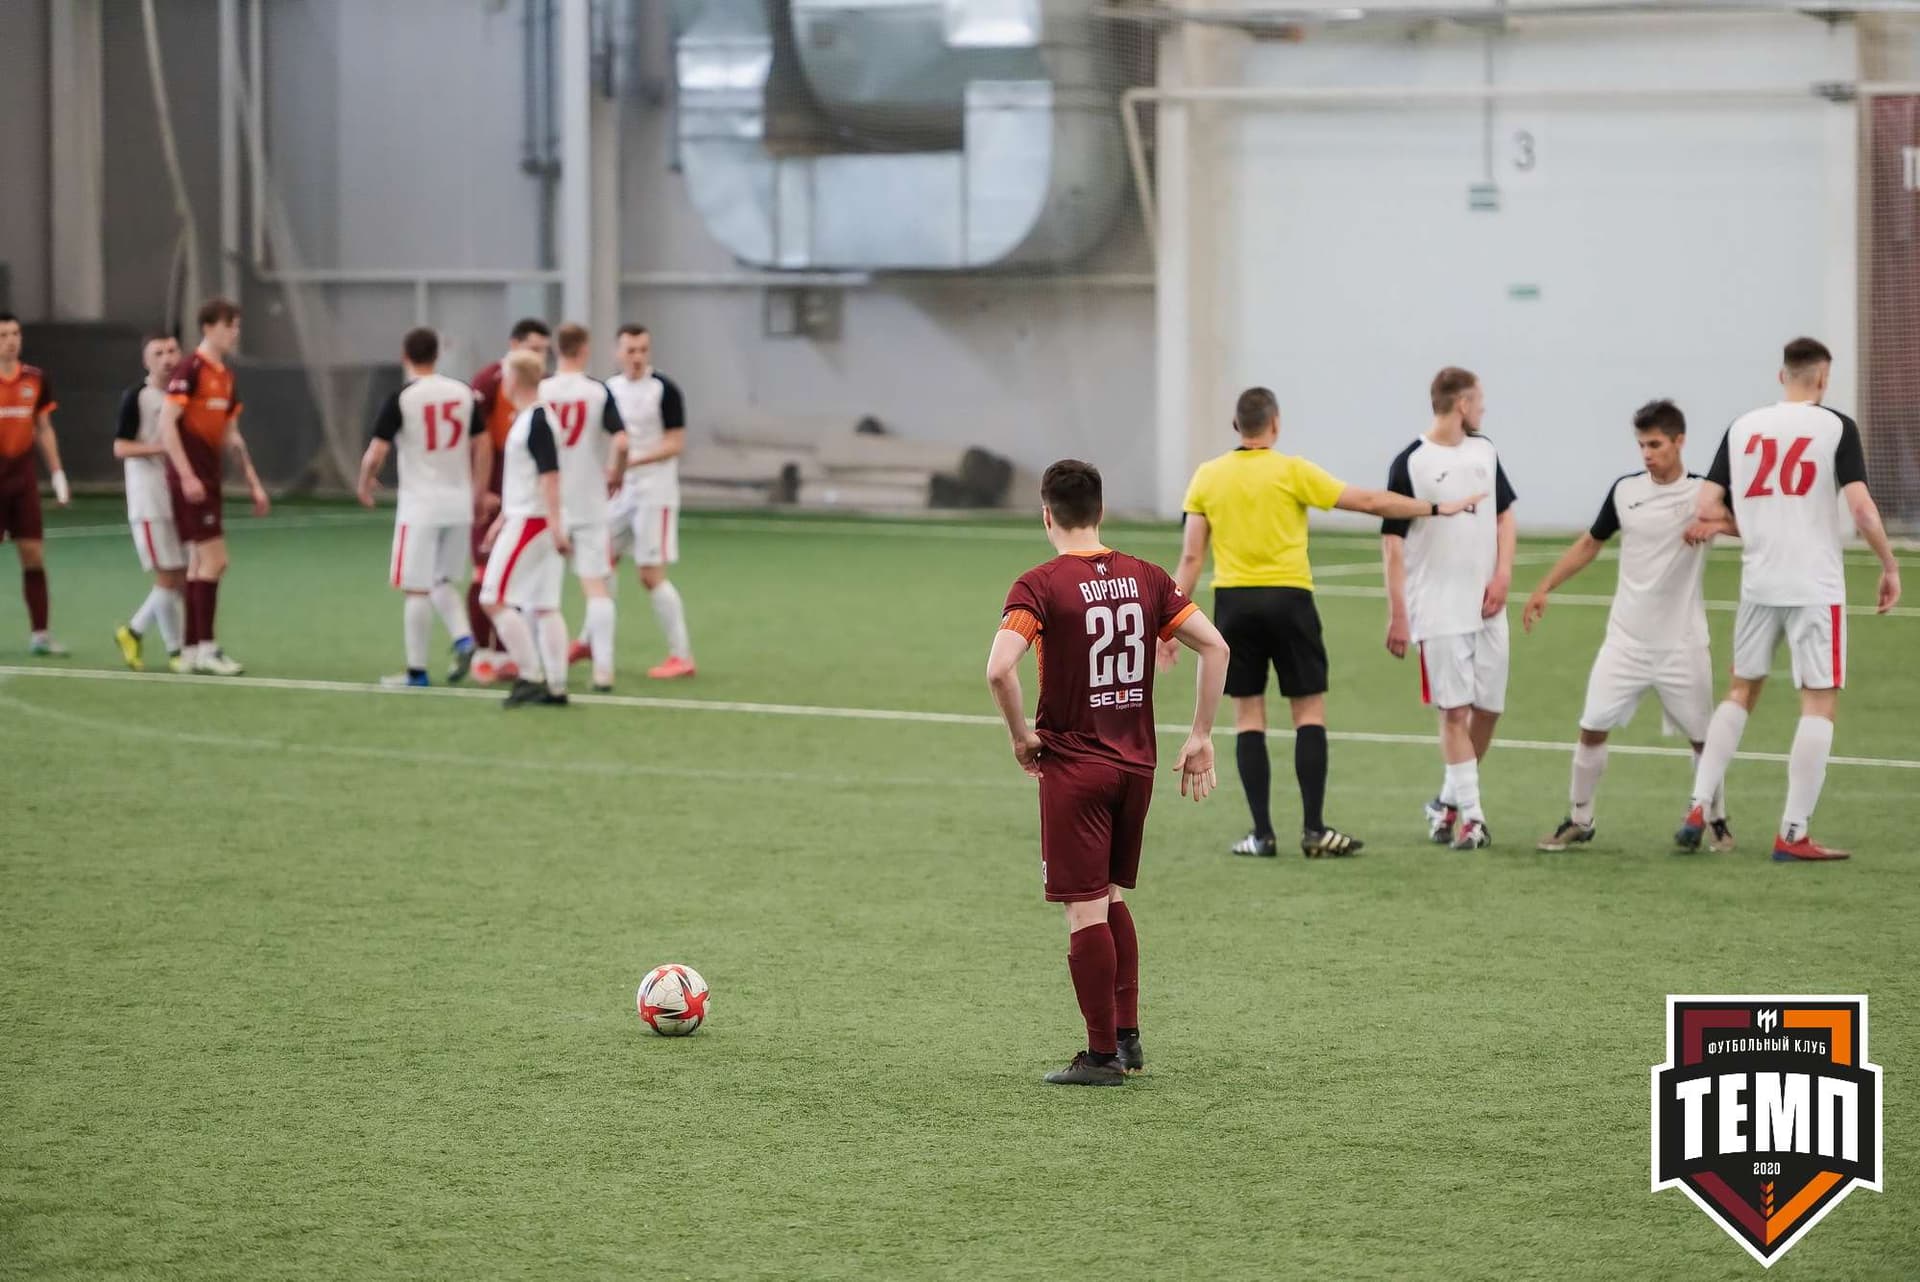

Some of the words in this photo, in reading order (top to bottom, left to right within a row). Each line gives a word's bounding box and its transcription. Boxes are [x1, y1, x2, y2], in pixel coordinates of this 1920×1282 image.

[1514, 130, 1536, 170] 3
[424, 401, 463, 451] 15
[549, 400, 587, 447] 9
[1744, 433, 1817, 498] 26
[1079, 577, 1139, 603] ВОРОНА
[1085, 602, 1145, 688] 23
[1089, 688, 1144, 708] SEUS
